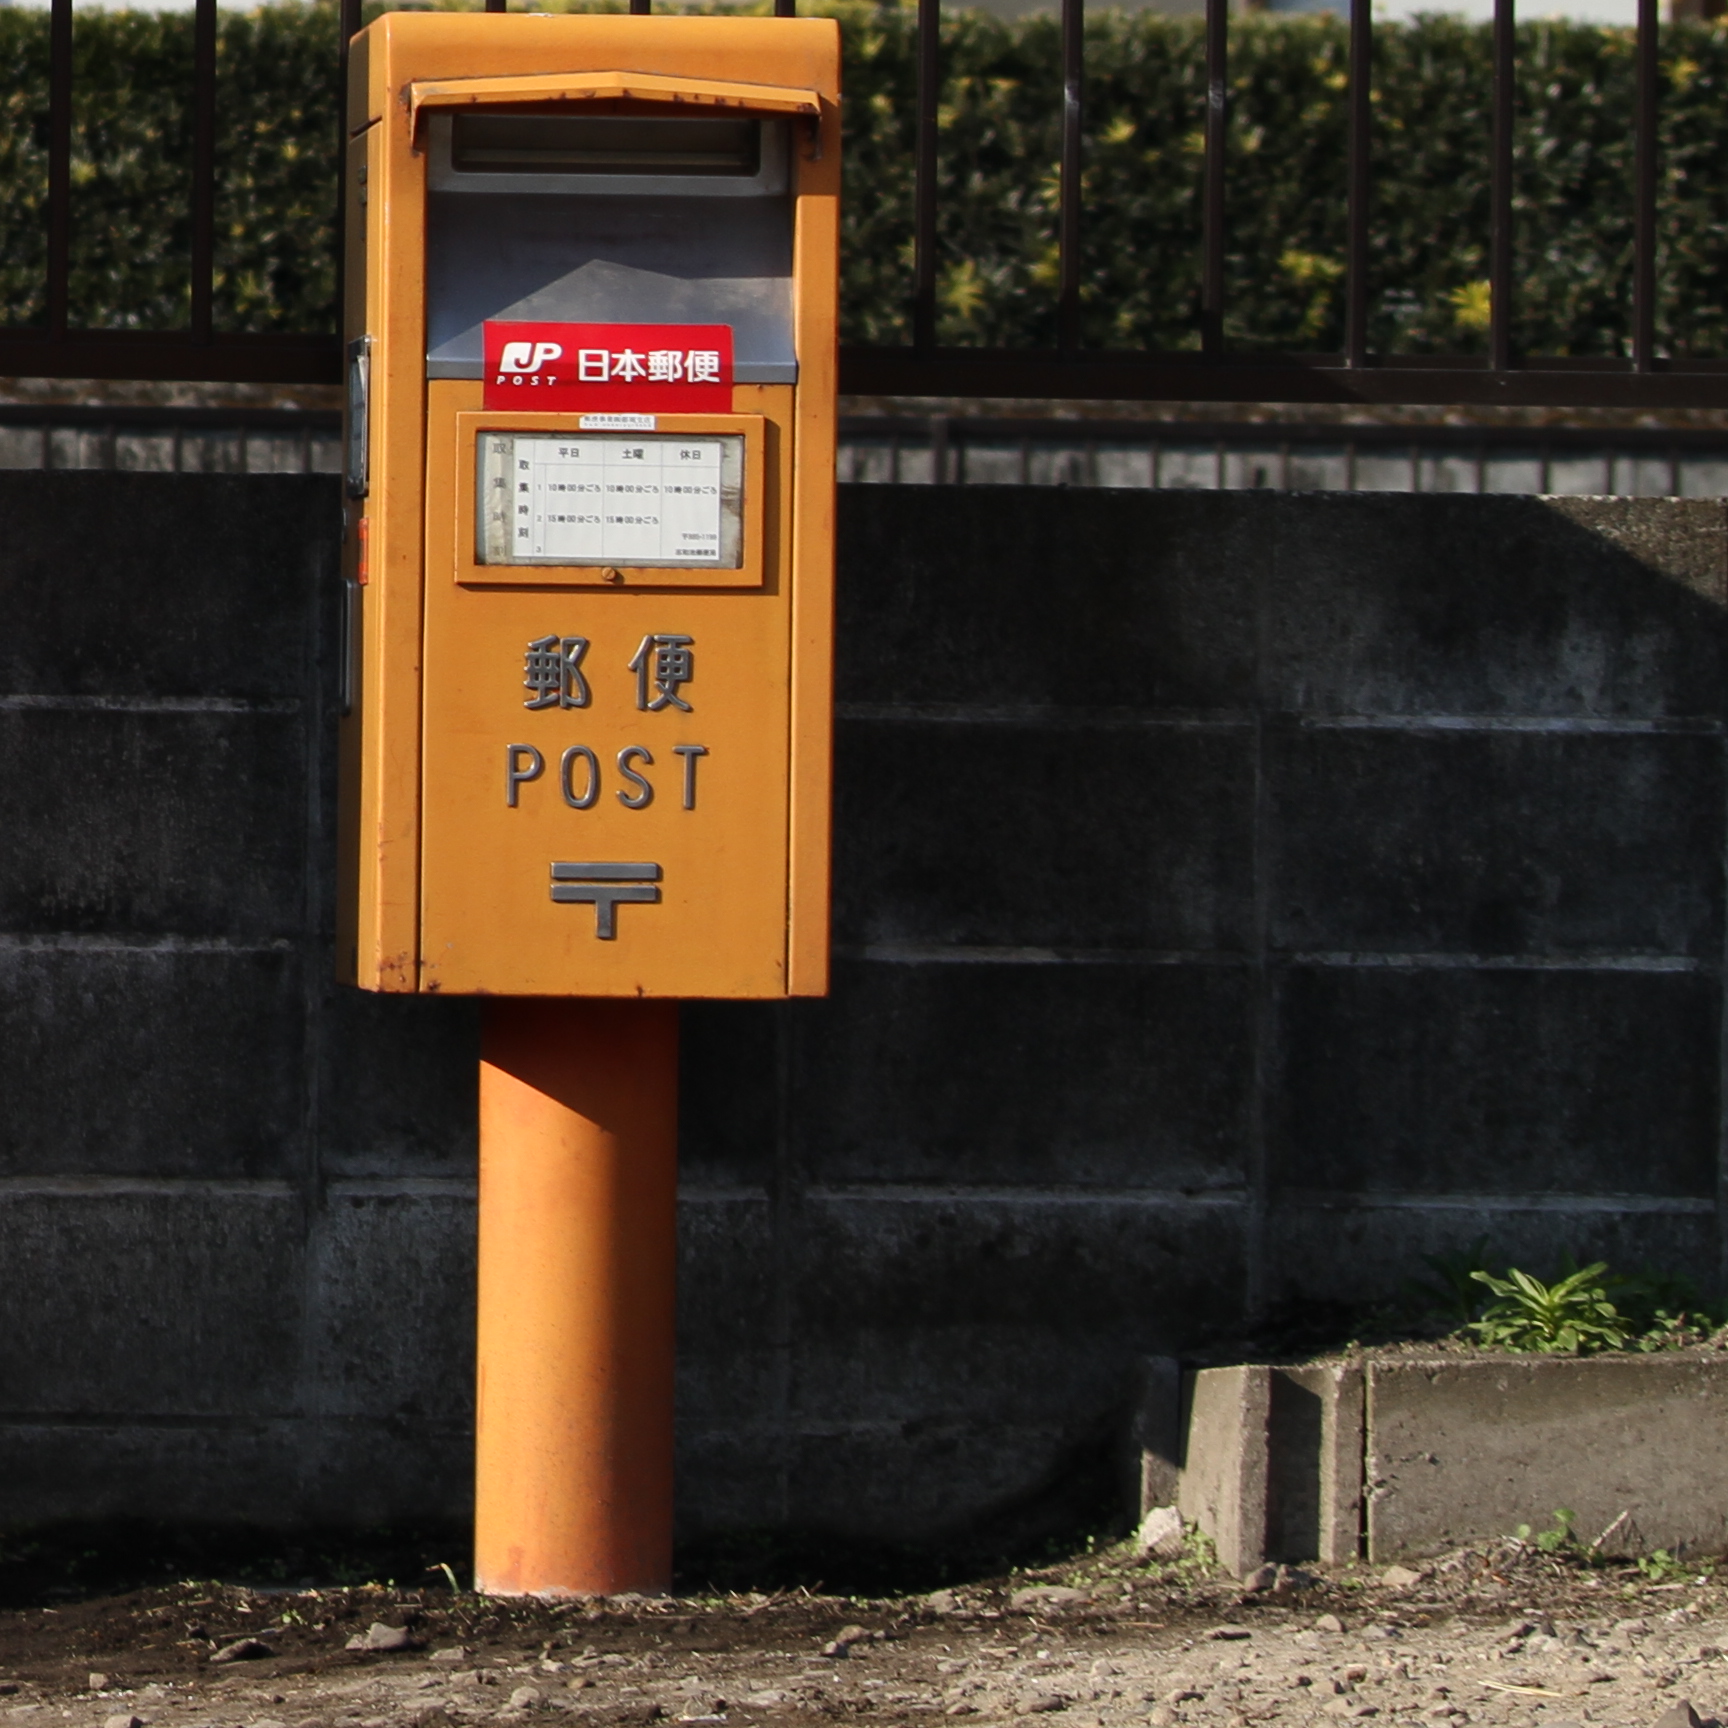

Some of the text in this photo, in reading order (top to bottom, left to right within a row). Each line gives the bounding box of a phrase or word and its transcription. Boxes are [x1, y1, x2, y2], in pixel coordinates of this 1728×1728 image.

[496, 375, 557, 386] POST
[577, 348, 721, 384] 日本郵便
[558, 447, 702, 461] 平日 土曜 休日
[517, 459, 530, 539] 取集時刻
[523, 633, 696, 713] 郵便
[505, 743, 711, 811] POST
